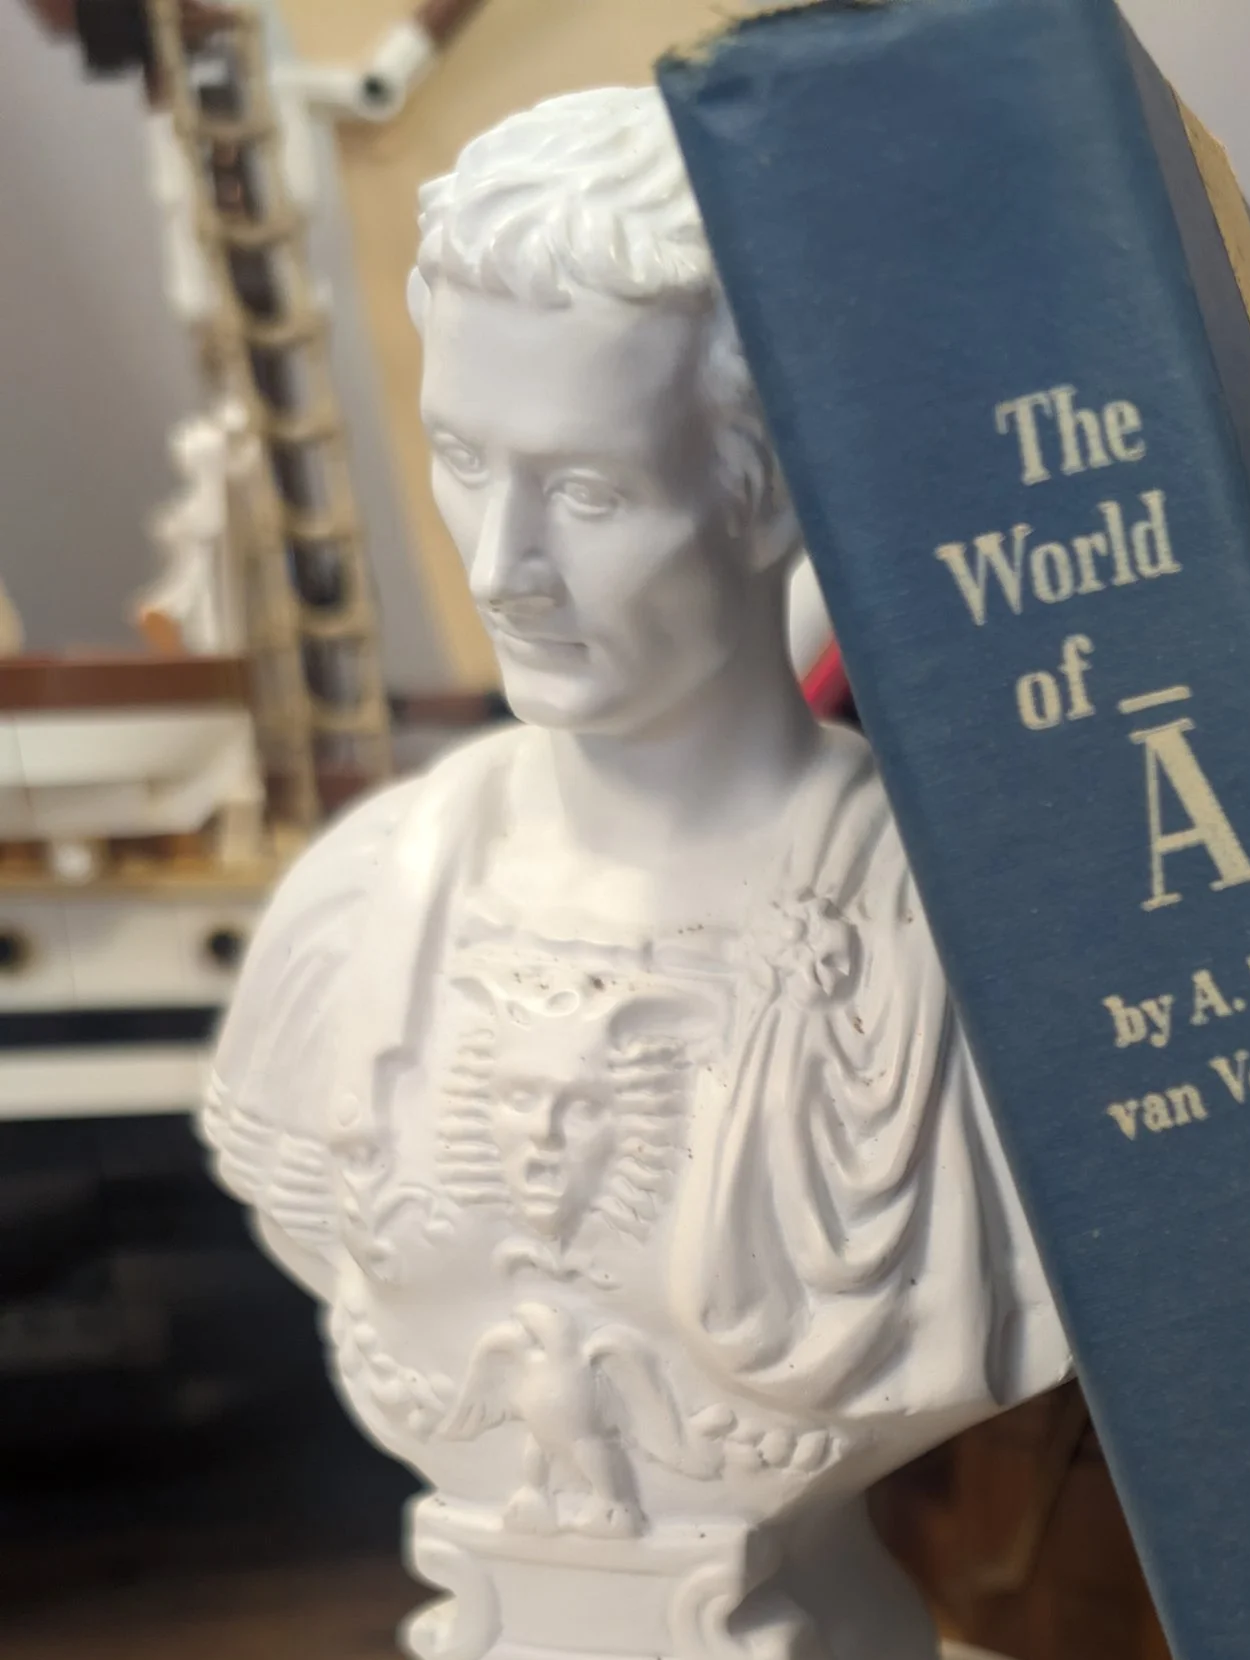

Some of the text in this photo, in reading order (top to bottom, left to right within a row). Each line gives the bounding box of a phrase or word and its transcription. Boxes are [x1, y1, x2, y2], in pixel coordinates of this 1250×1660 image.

[995, 384, 1147, 486] The
[934, 489, 1183, 626] World
[1015, 633, 1096, 731] of
[1102, 994, 1175, 1049] by
[1190, 968, 1246, 1026] A.
[1106, 1083, 1209, 1141] van
